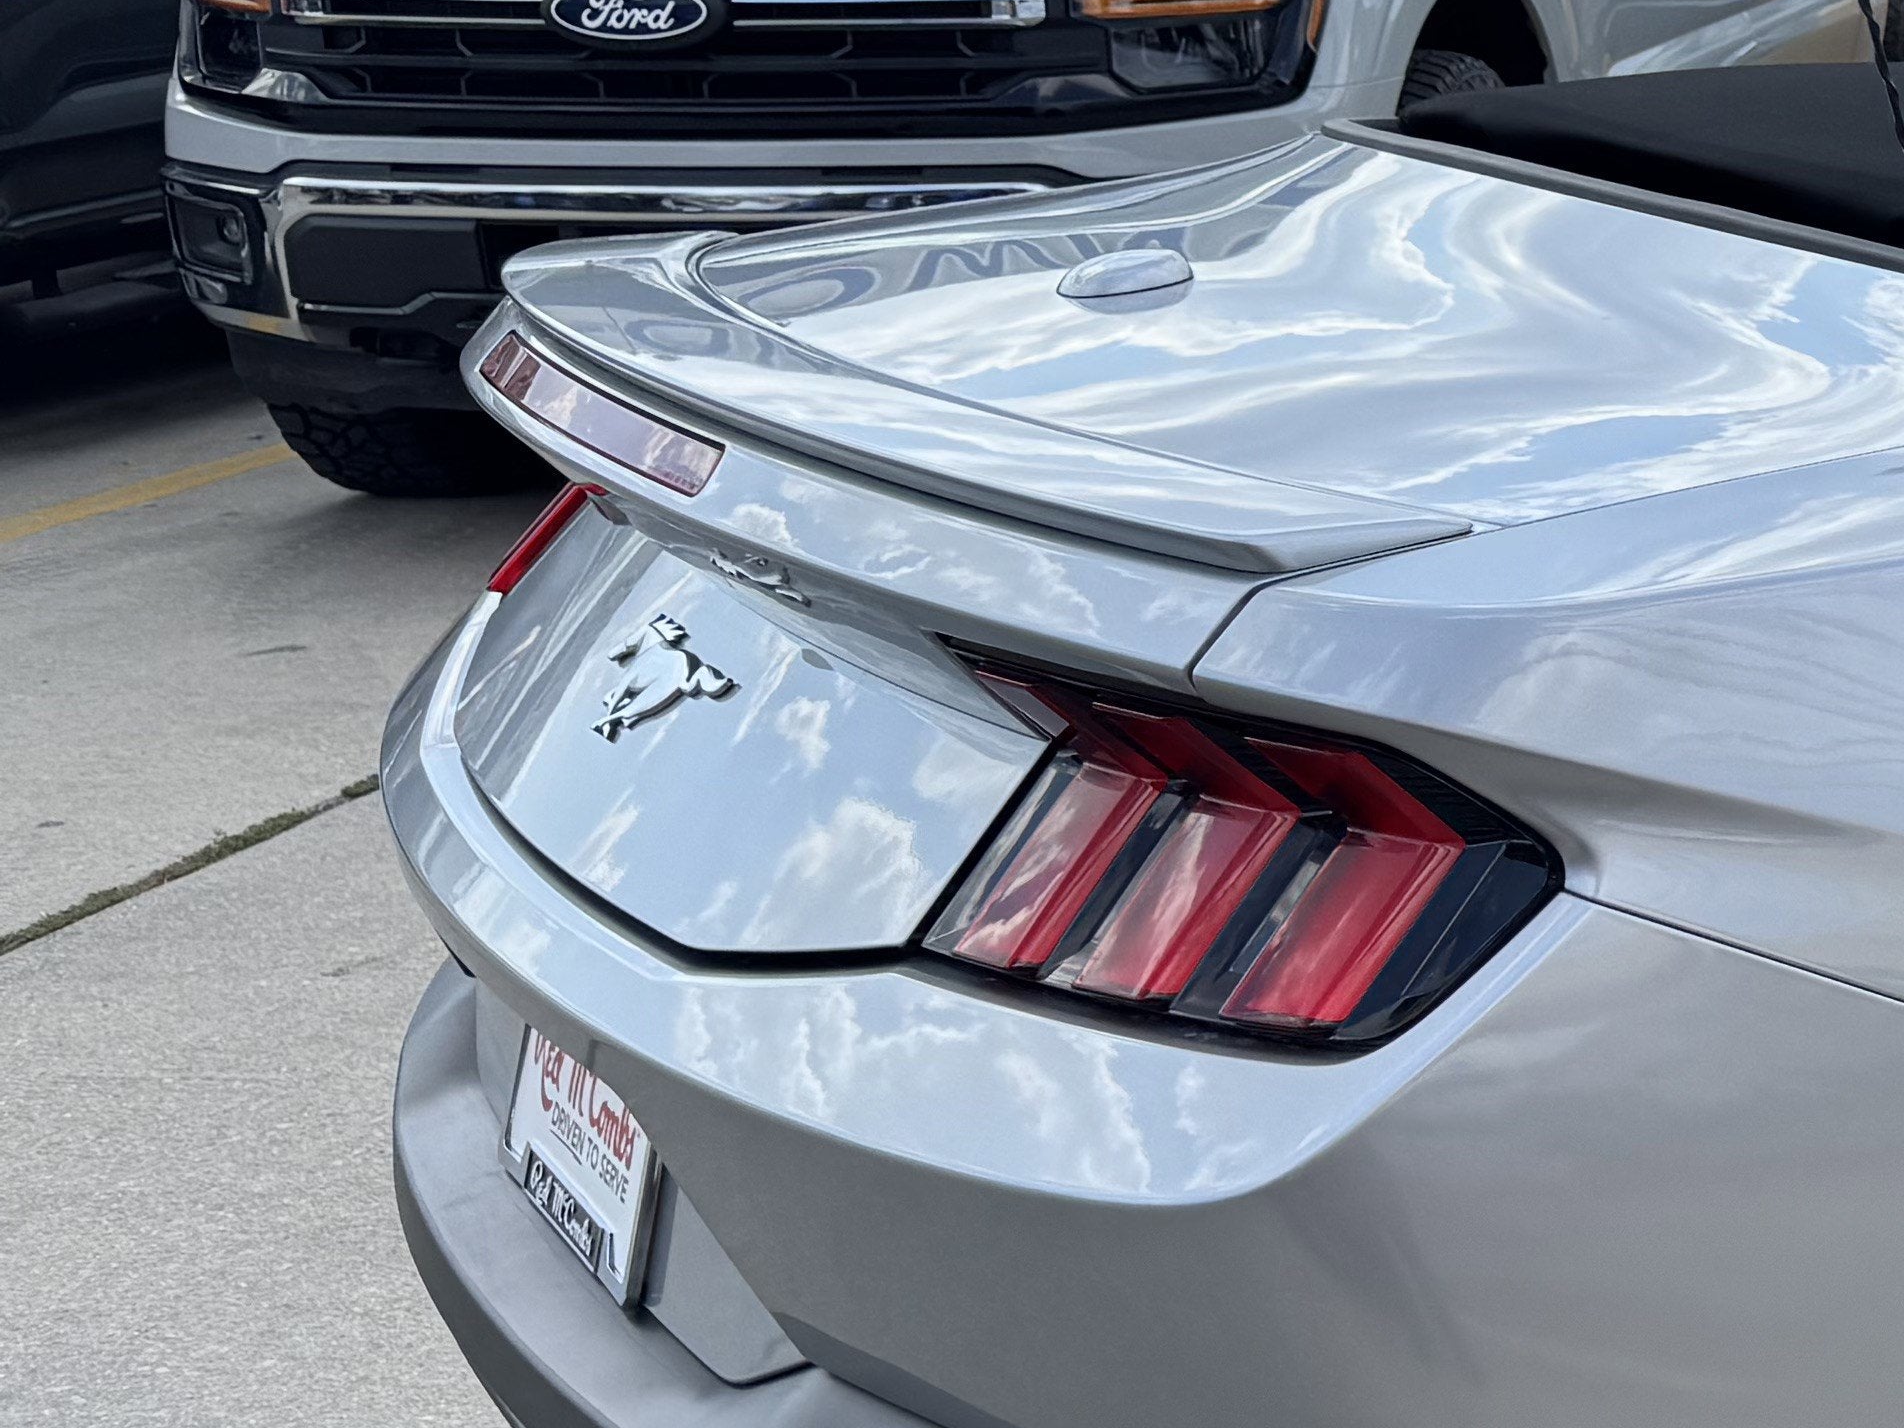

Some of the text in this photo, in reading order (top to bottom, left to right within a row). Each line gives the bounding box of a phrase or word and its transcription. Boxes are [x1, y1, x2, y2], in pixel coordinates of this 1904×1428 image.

[551, 1101, 630, 1204] DRIVEN TO SERVE
